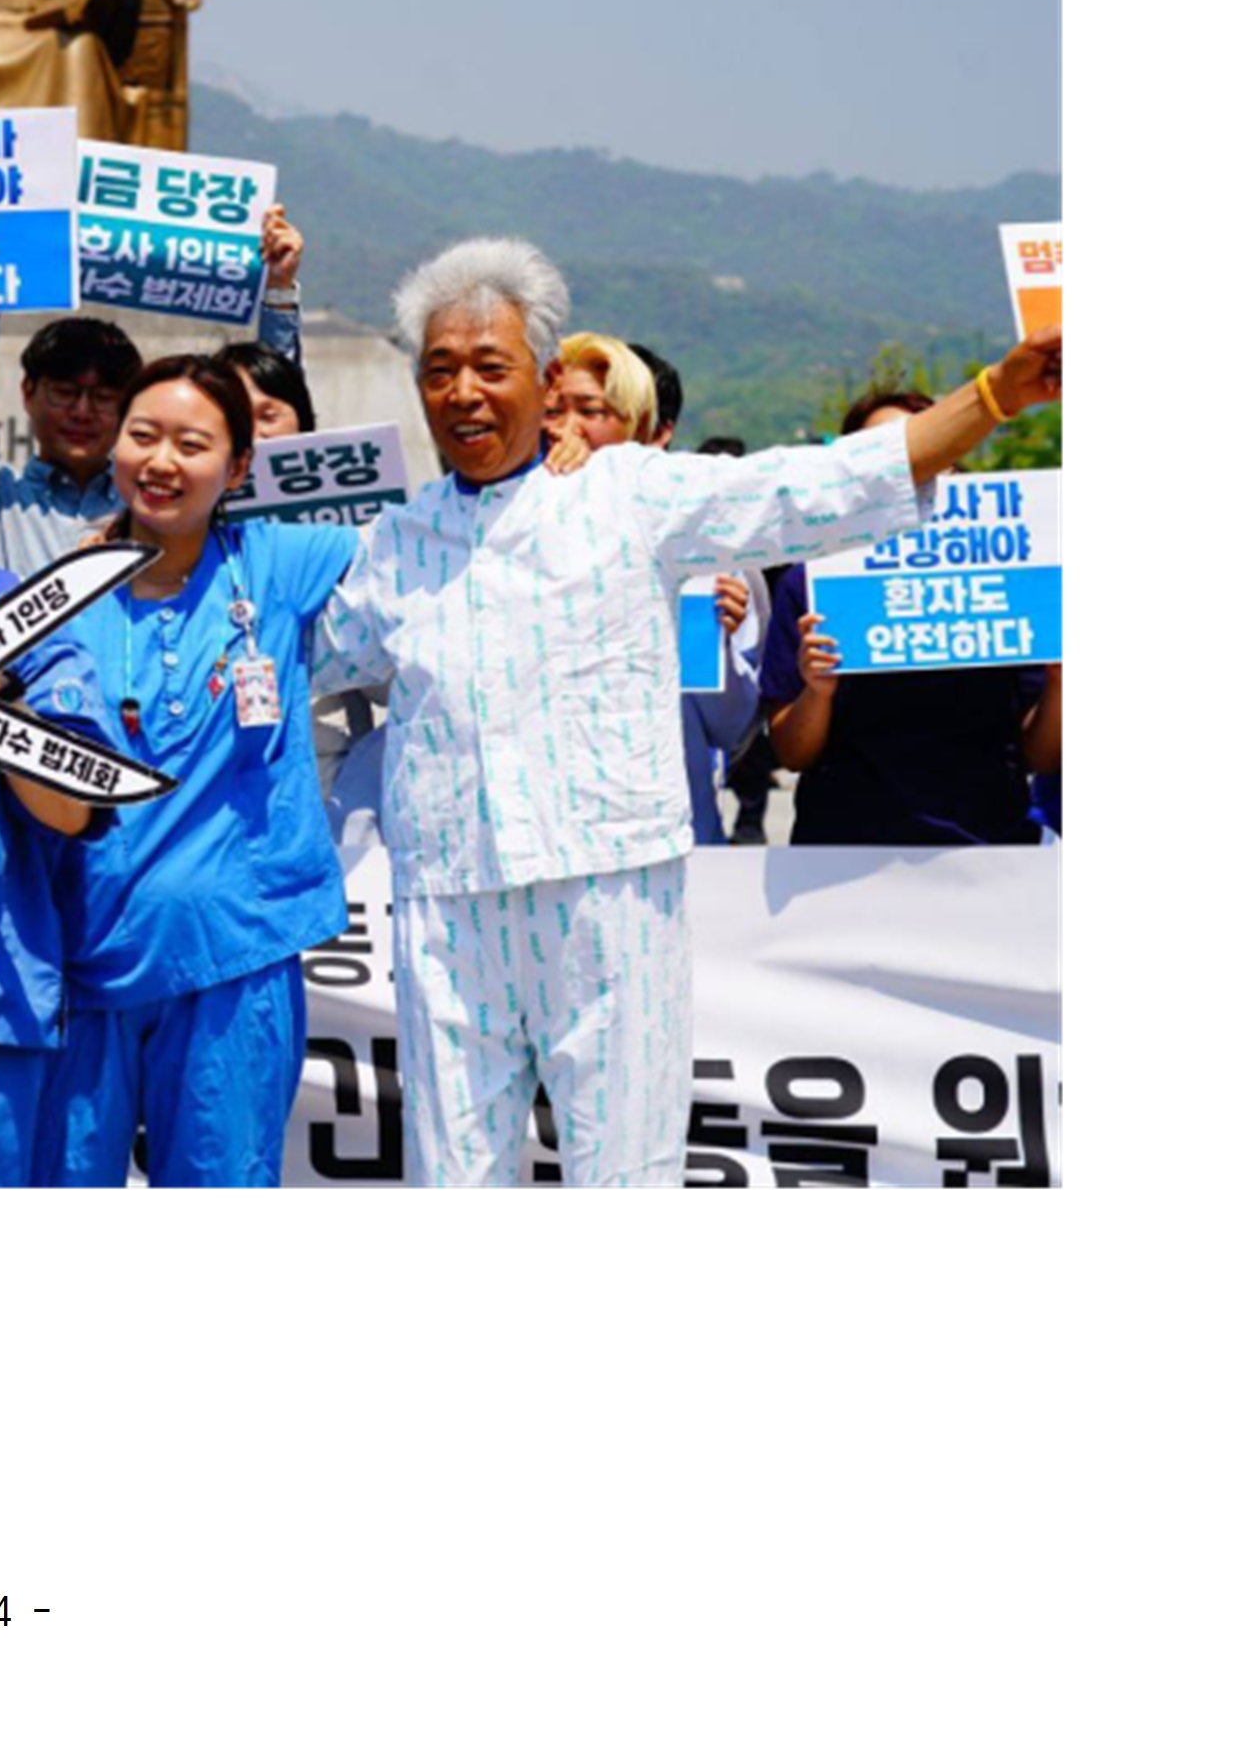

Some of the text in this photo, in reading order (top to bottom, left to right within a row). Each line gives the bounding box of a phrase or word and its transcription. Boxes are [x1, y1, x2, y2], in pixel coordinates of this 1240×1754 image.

[156, 167, 257, 224] 당장
[79, 224, 256, 281] 호사 1인당
[1017, 239, 1062, 275] 멈
[140, 276, 253, 317] 법제화
[268, 441, 381, 495] 당장
[6, 578, 71, 634] 1인당
[884, 573, 1009, 618] 환자도
[866, 618, 1034, 664] 안전하다
[39, 739, 121, 794] 법제화
